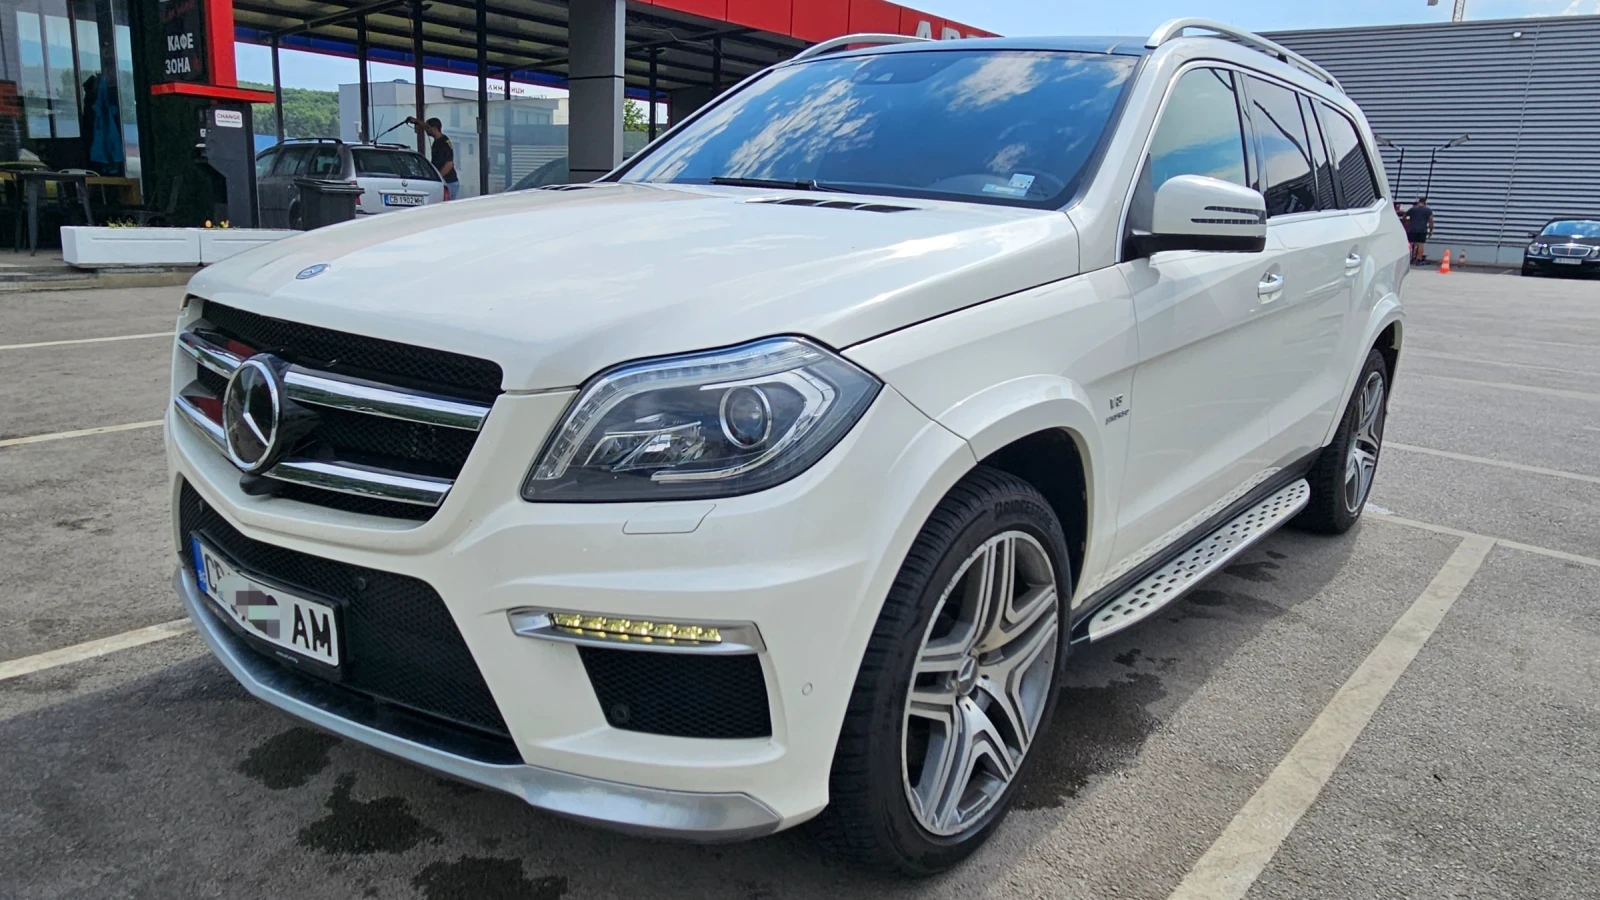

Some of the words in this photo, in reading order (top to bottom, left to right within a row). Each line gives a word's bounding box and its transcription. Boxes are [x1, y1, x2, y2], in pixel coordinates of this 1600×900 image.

[167, 32, 194, 51] КАФЕ
[165, 56, 191, 74] ЗОНА
[291, 603, 333, 658] AM
